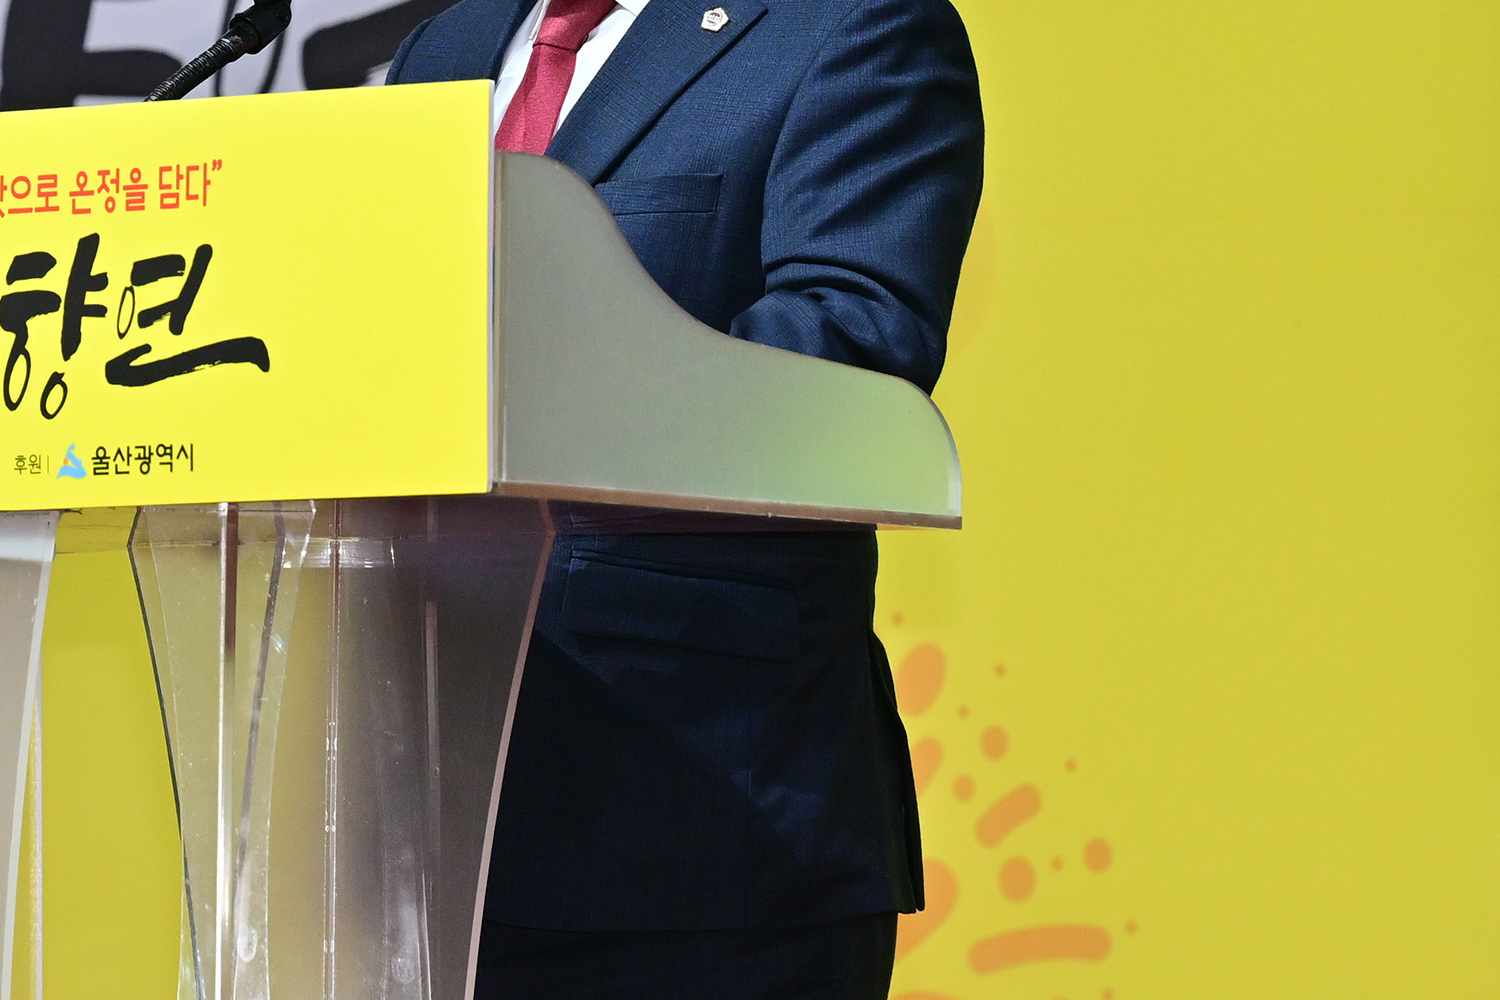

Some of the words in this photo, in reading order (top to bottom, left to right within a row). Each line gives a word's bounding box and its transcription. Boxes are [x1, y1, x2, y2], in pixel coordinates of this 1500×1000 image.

[69, 167, 149, 215] 온정을
[13, 454, 41, 475] 후원
[91, 443, 194, 476] 울산광역시
